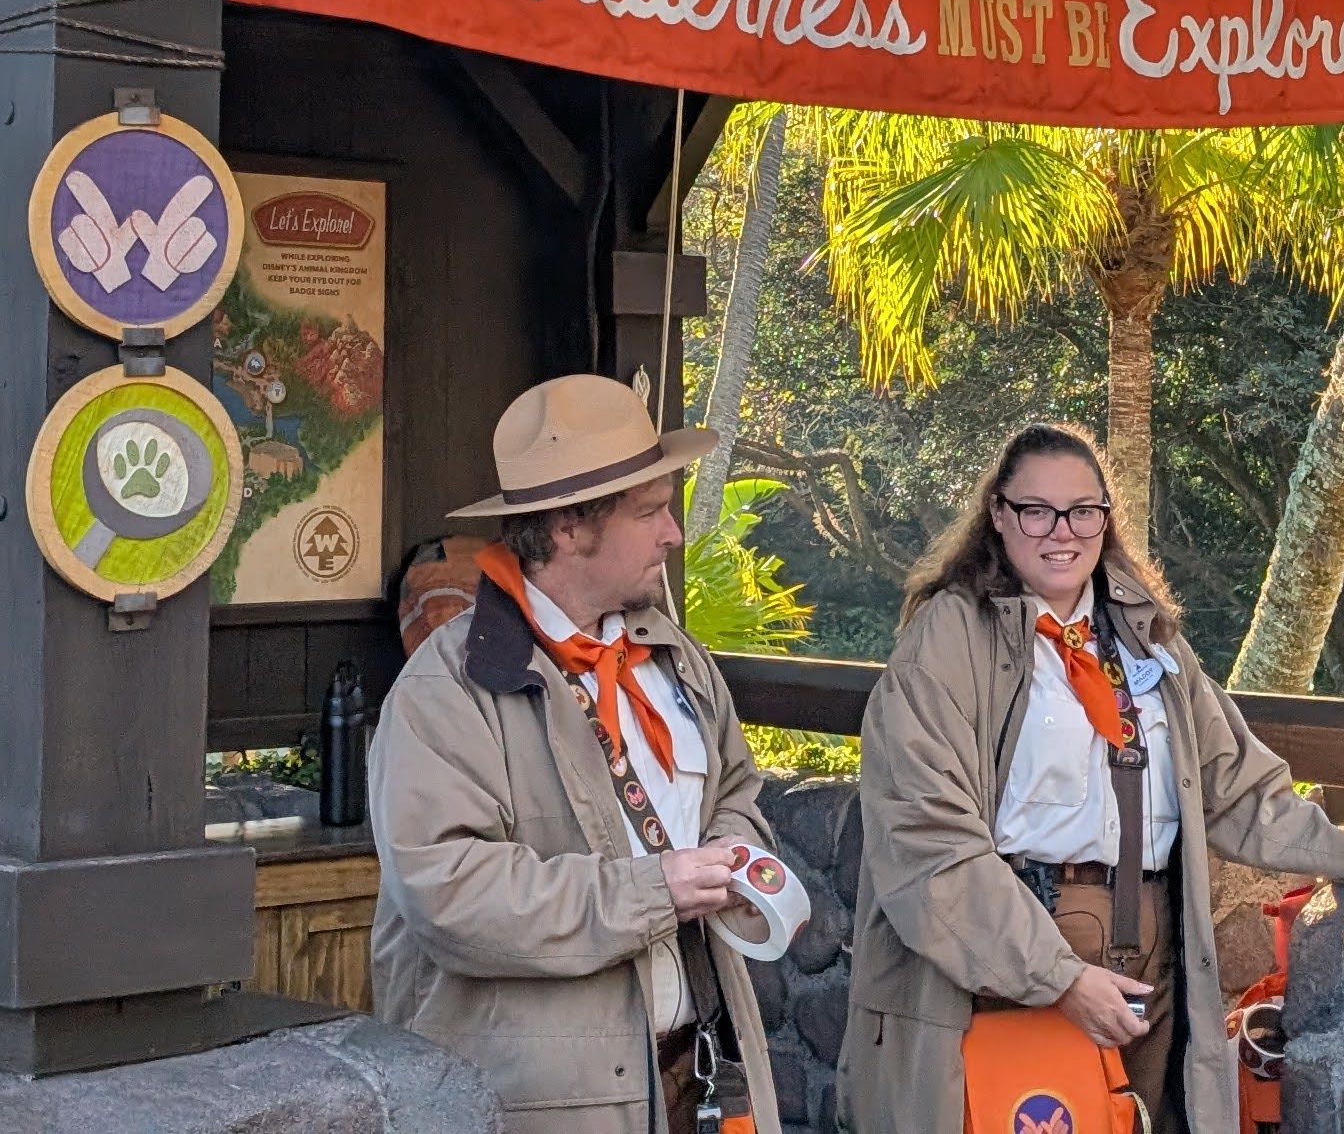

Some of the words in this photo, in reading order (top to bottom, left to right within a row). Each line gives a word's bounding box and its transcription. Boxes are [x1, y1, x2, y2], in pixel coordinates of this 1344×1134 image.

[269, 206, 299, 231] Let's
[302, 208, 355, 241] Explore!
[281, 253, 306, 261] WHILE
[306, 254, 351, 263] EXPLORING
[262, 263, 297, 272] DISNEY'S
[298, 265, 328, 274] ANIMAL
[329, 267, 368, 275] KINGDOM
[267, 274, 288, 283] KEEP
[289, 275, 311, 284] YOUR
[327, 277, 345, 286] OUT
[289, 287, 317, 295] BADGE
[317, 288, 341, 297] SIGNS
